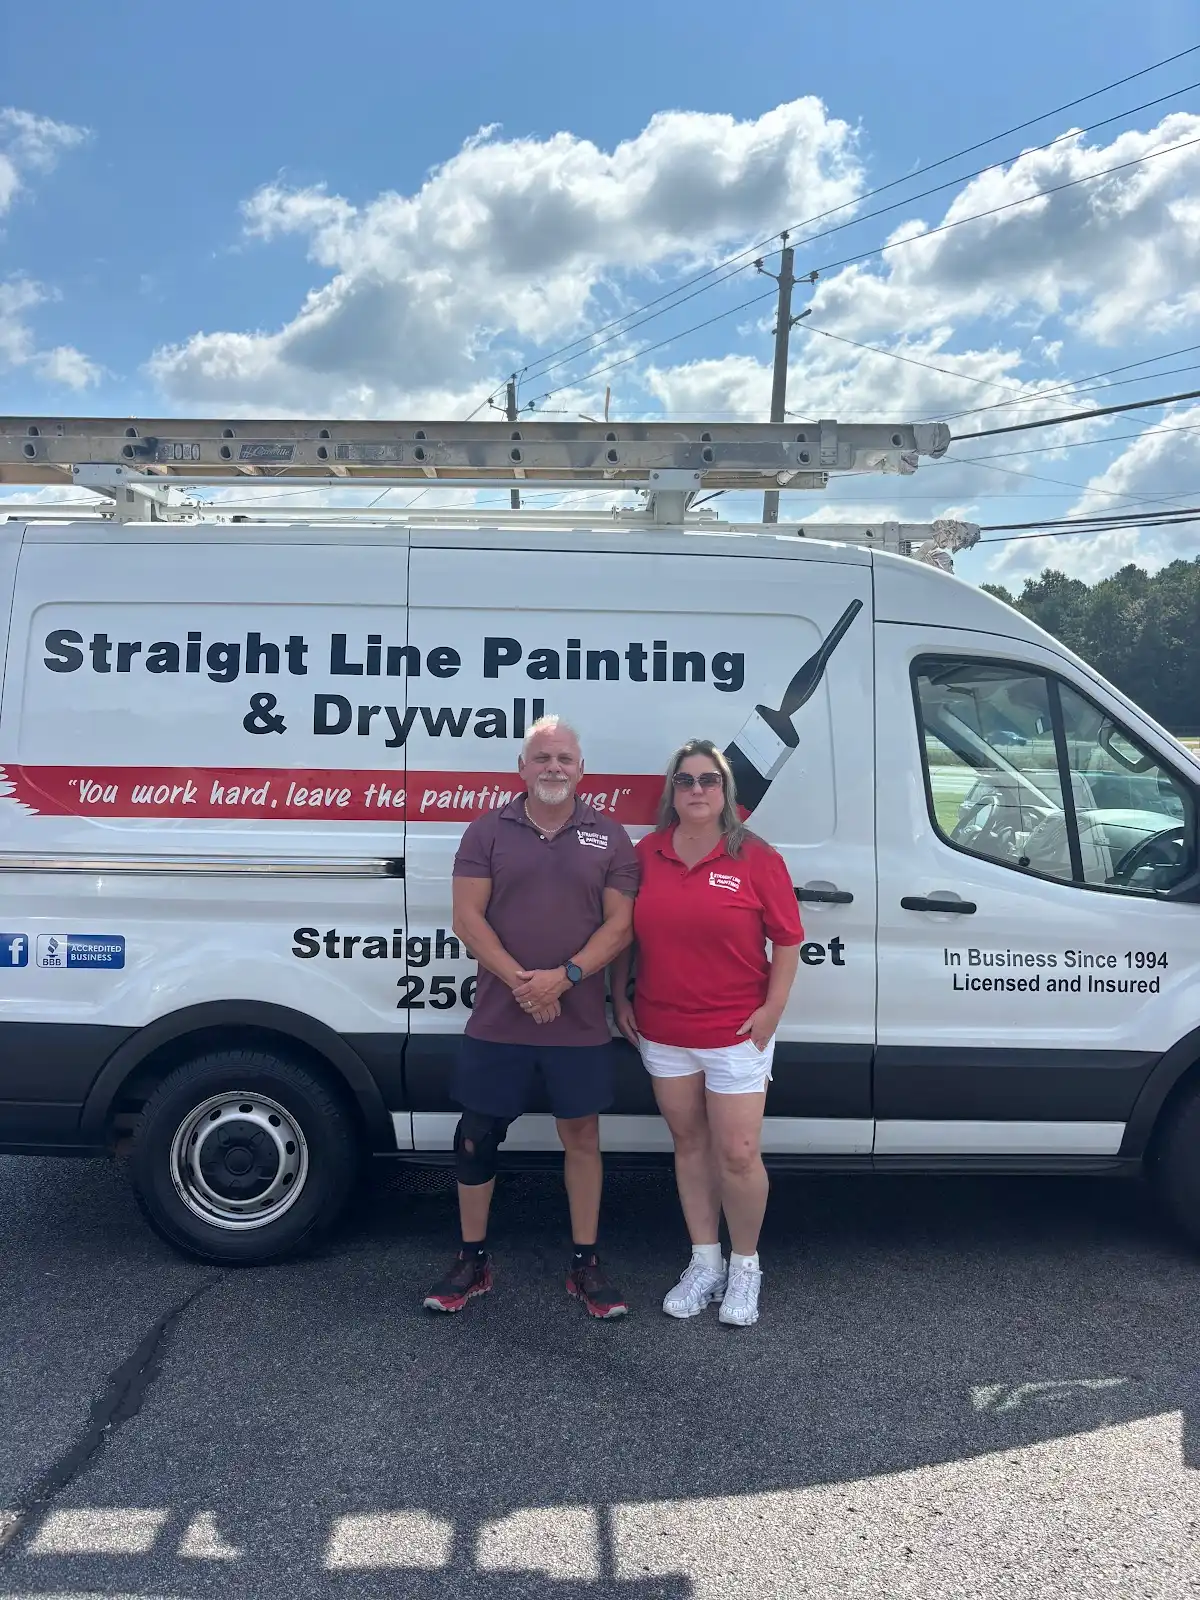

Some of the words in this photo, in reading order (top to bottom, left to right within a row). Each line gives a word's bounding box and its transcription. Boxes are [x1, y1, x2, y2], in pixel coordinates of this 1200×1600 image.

[43, 629, 309, 683] Straight
[330, 633, 462, 679] Line
[483, 636, 745, 692] Painting
[242, 692, 288, 735] &
[131, 780, 198, 805] work
[209, 780, 278, 808] hard,
[286, 781, 351, 807] leave
[363, 782, 406, 808] the
[8, 937, 24, 965] f
[70, 953, 112, 962] BUSINESS
[71, 944, 122, 953] ACCREDITED
[291, 927, 476, 967] Straigh
[943, 948, 961, 966] In
[968, 948, 1058, 967] Business
[1064, 949, 1117, 969] Since
[1124, 950, 1169, 969] 1994
[42, 958, 62, 966] BBB
[953, 973, 1040, 992] Licensed
[1046, 974, 1081, 993] and
[1088, 975, 1160, 994] Insured
